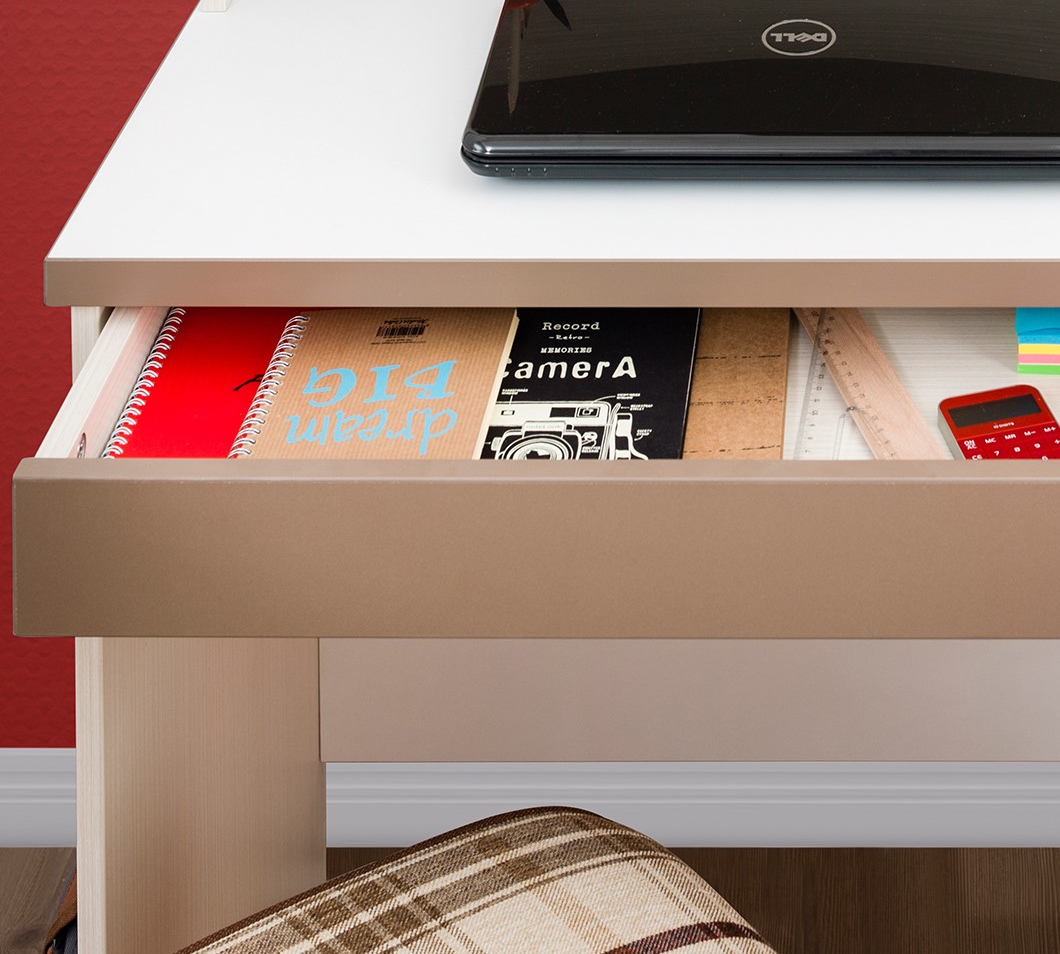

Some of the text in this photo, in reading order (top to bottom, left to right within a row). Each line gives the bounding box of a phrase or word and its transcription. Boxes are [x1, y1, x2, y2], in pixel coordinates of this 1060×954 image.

[770, 32, 828, 42] DELL
[542, 321, 600, 331] Record
[302, 359, 458, 407] BIG
[284, 408, 459, 456] dream
